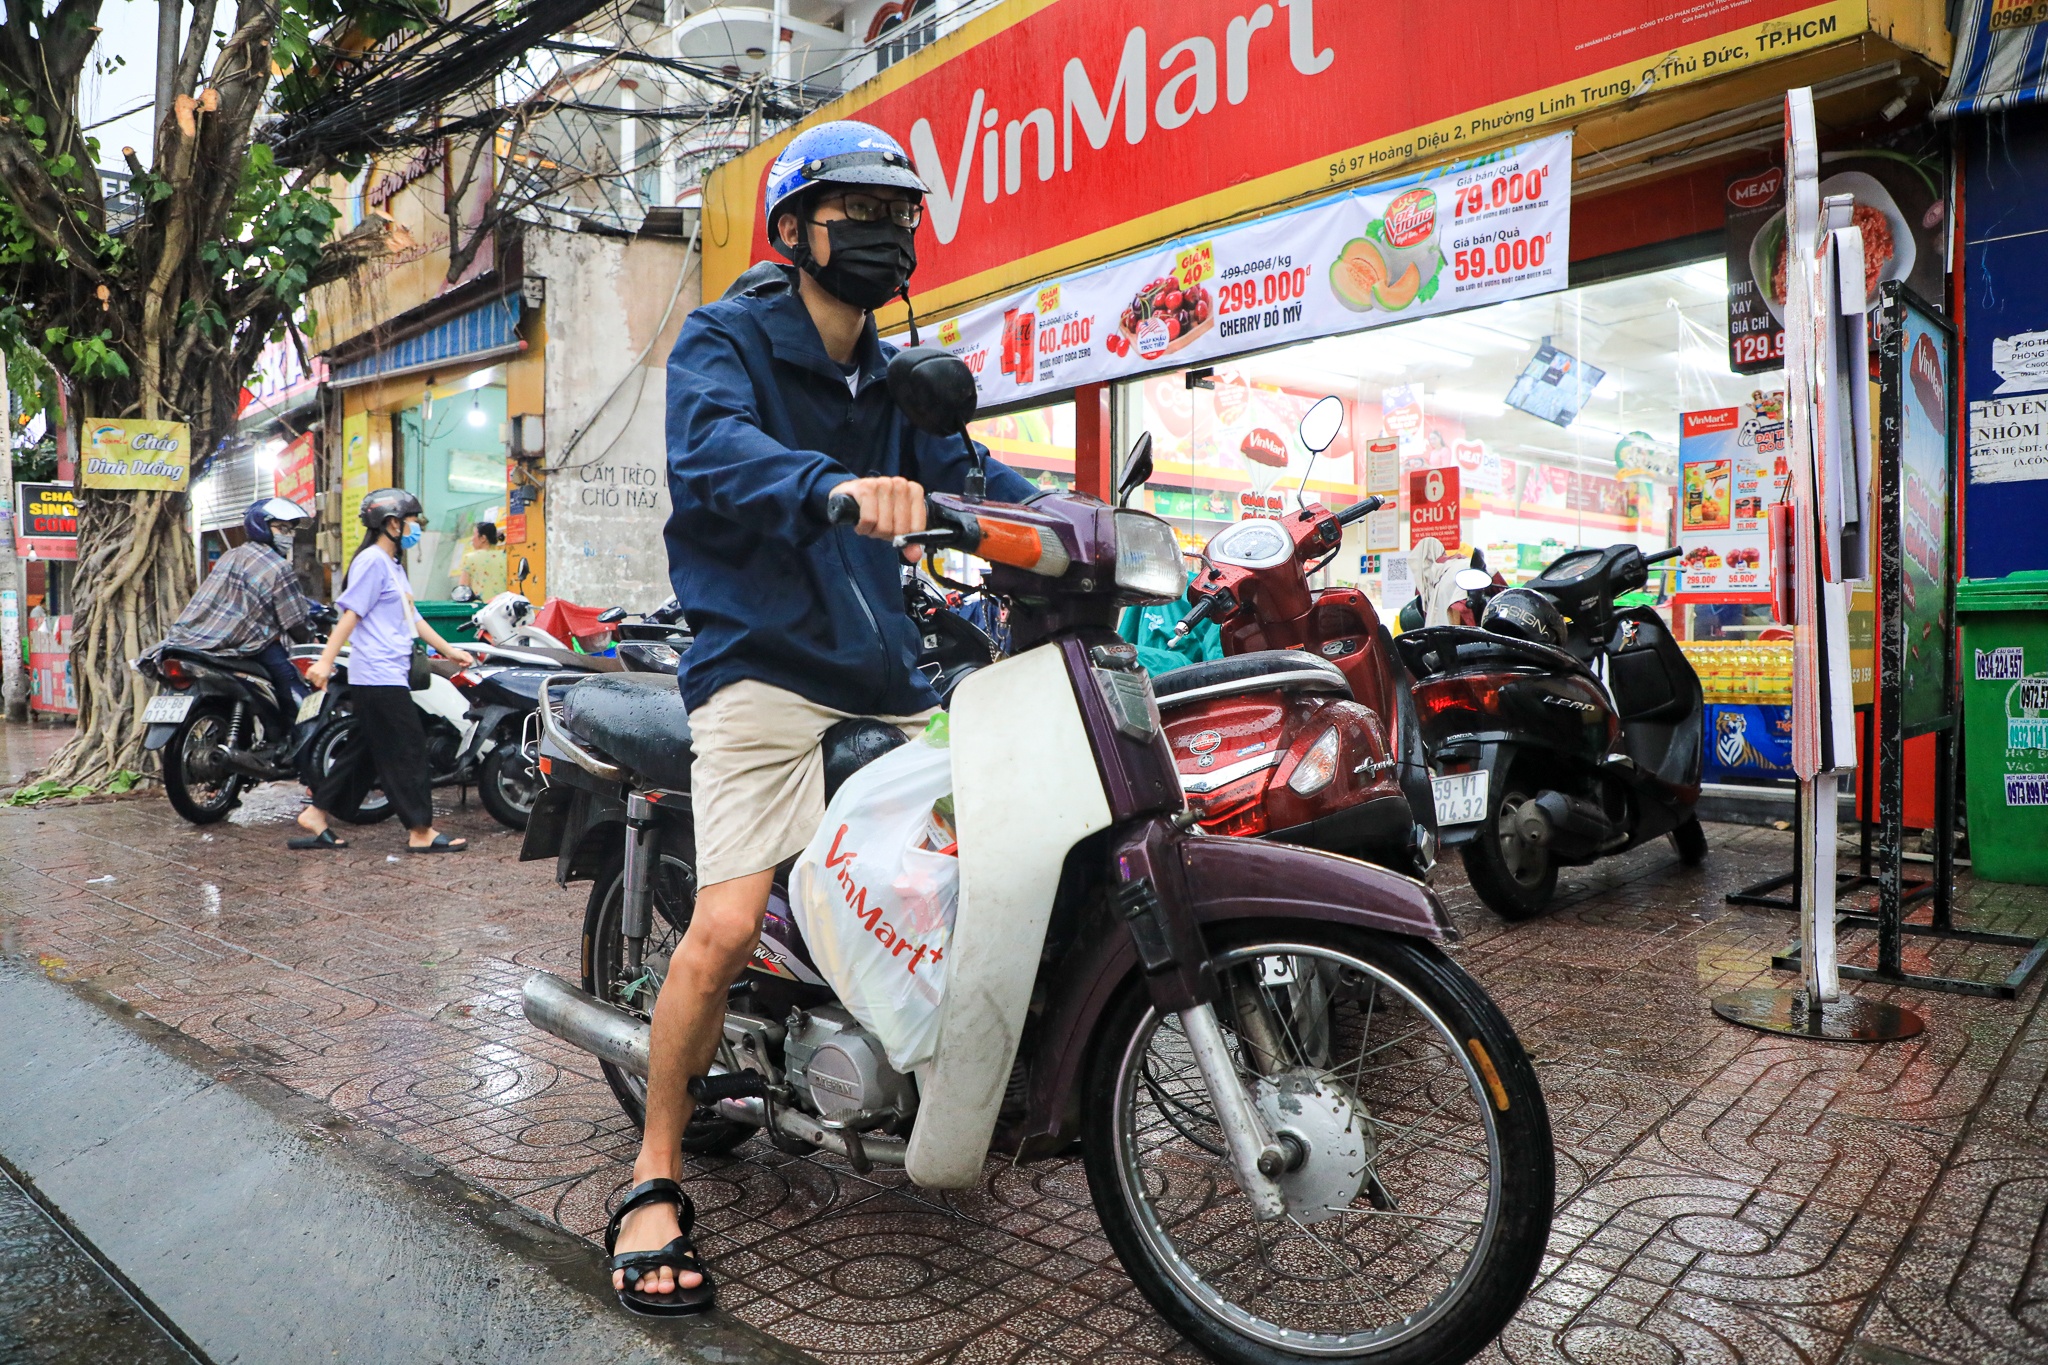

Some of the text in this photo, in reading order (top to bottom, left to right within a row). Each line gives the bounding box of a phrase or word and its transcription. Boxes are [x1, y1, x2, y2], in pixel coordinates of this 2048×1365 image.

[1329, 158, 1346, 177] Số
[1349, 156, 1365, 171] 97
[1369, 142, 1413, 166] Hoàng
[1417, 129, 1449, 152] Diệu
[1453, 125, 1466, 141] 2,
[1471, 107, 1534, 135] Phường
[1540, 93, 1575, 115] Linh
[1581, 79, 1636, 103] Trung,
[1703, 45, 1750, 68] Đức,
[1756, 15, 1837, 53] TP.HCM
[911, 0, 1334, 245] VinMart
[1456, 161, 1520, 187] Giá bán/Quả
[1735, 178, 1777, 200] MEAT
[1453, 227, 1520, 249] Giá bán/Quả
[1182, 261, 1212, 286] 40%
[1731, 280, 1754, 298] THỊT
[1219, 301, 1303, 338] CHERRY ĐỎ MỸ
[1731, 300, 1752, 316] XAY
[1731, 318, 1748, 335] GIÁ
[1978, 421, 2040, 441] NHÔM
[1249, 431, 1285, 458] VinMart
[621, 463, 657, 487] TRÈO
[1412, 501, 1458, 524] CHÚ Ý
[1361, 555, 1381, 574] JCB
[1977, 654, 2023, 679] 0934.224.557
[1446, 732, 1474, 741] HONDA
[1434, 776, 1477, 801] 59-V1
